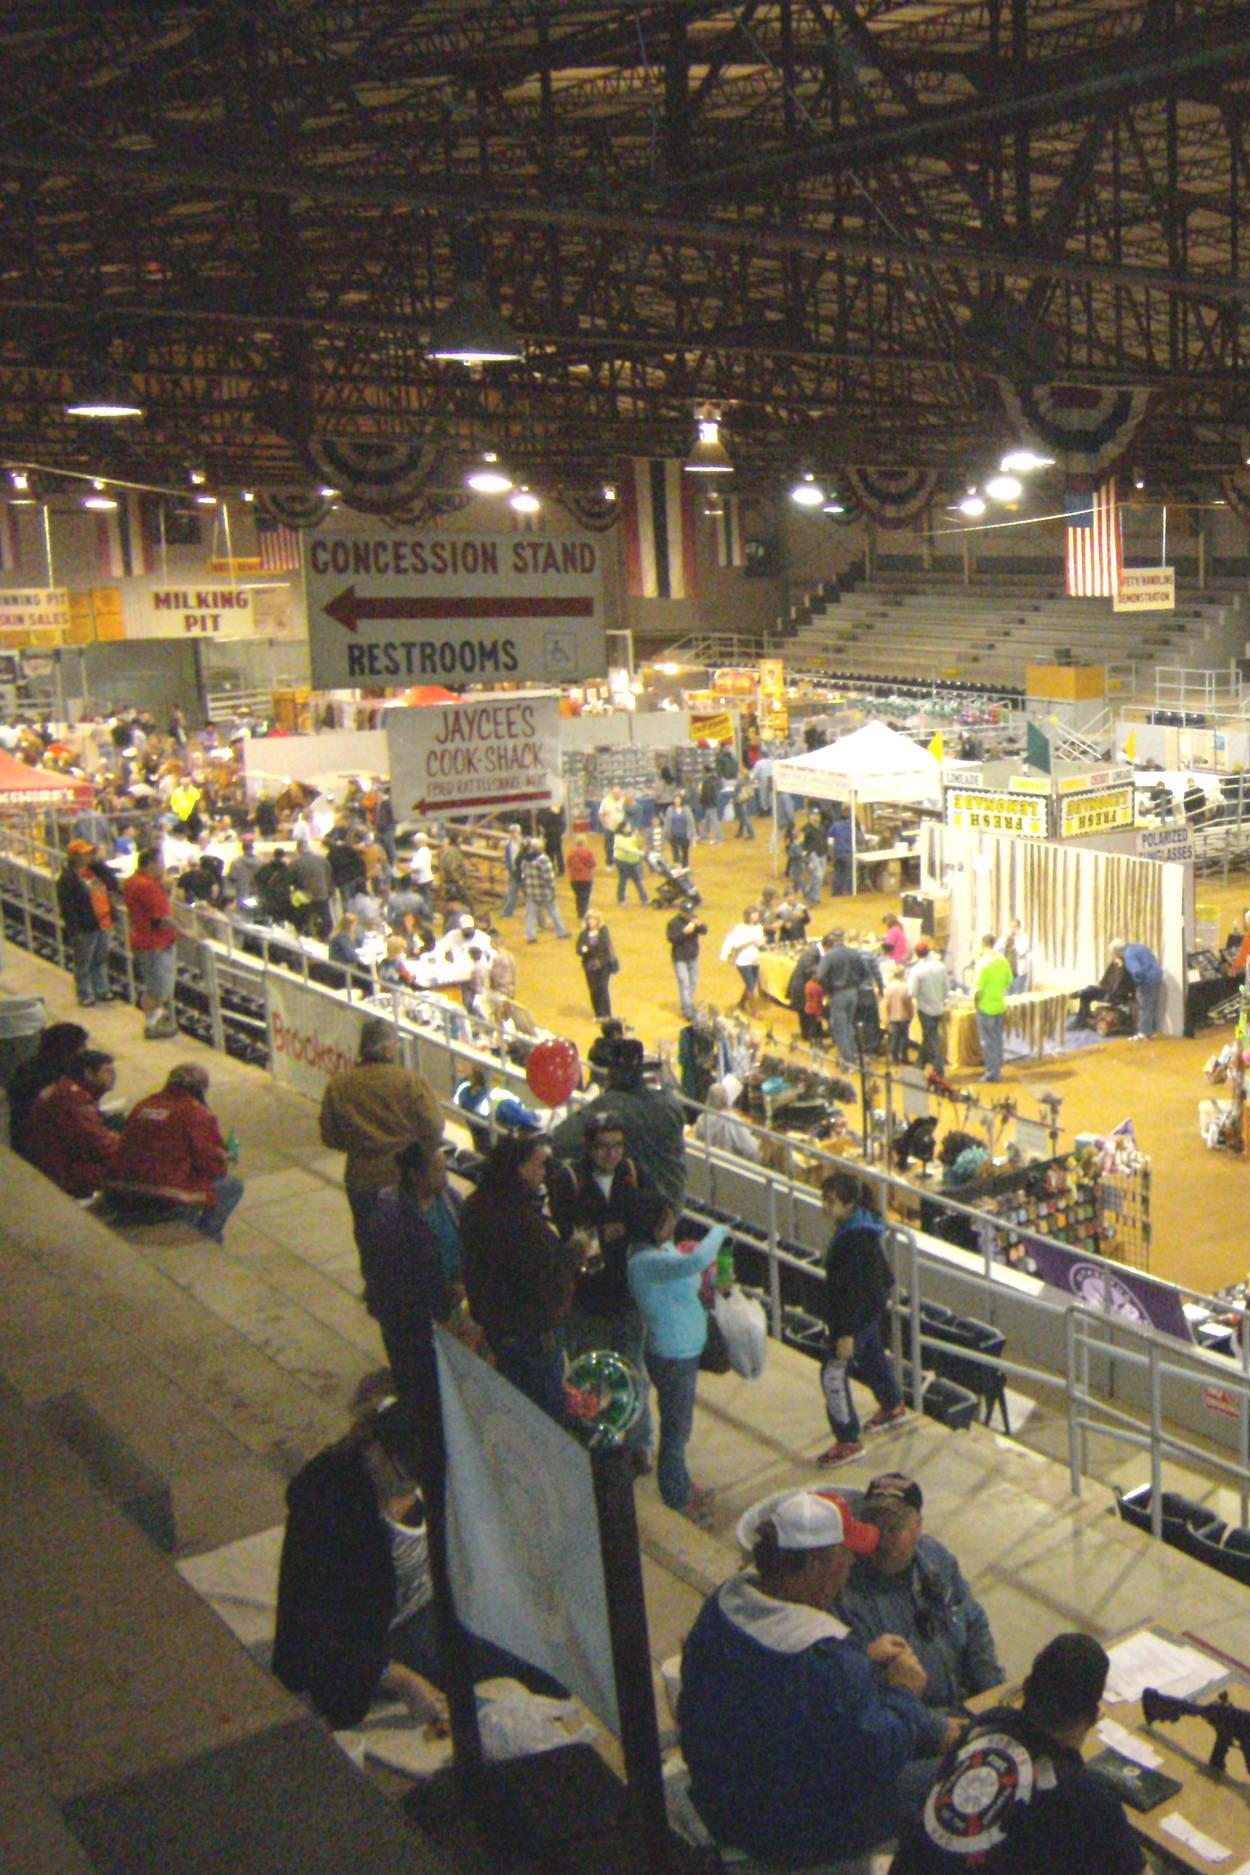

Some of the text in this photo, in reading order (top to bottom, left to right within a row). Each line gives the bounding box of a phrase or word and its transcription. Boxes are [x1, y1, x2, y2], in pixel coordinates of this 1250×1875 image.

[310, 540, 596, 575] CONCESSION STAND
[154, 591, 249, 611] MILKING
[29, 611, 69, 626] SALES
[184, 614, 222, 633] PIT
[347, 640, 519, 677] RESTROOMS
[435, 702, 537, 745] JAYCEE'S
[953, 794, 1039, 817] LEMONADE
[970, 813, 1023, 832] FRESH
[1077, 809, 1117, 829] FRESH
[1141, 828, 1188, 848] POLARIZED
